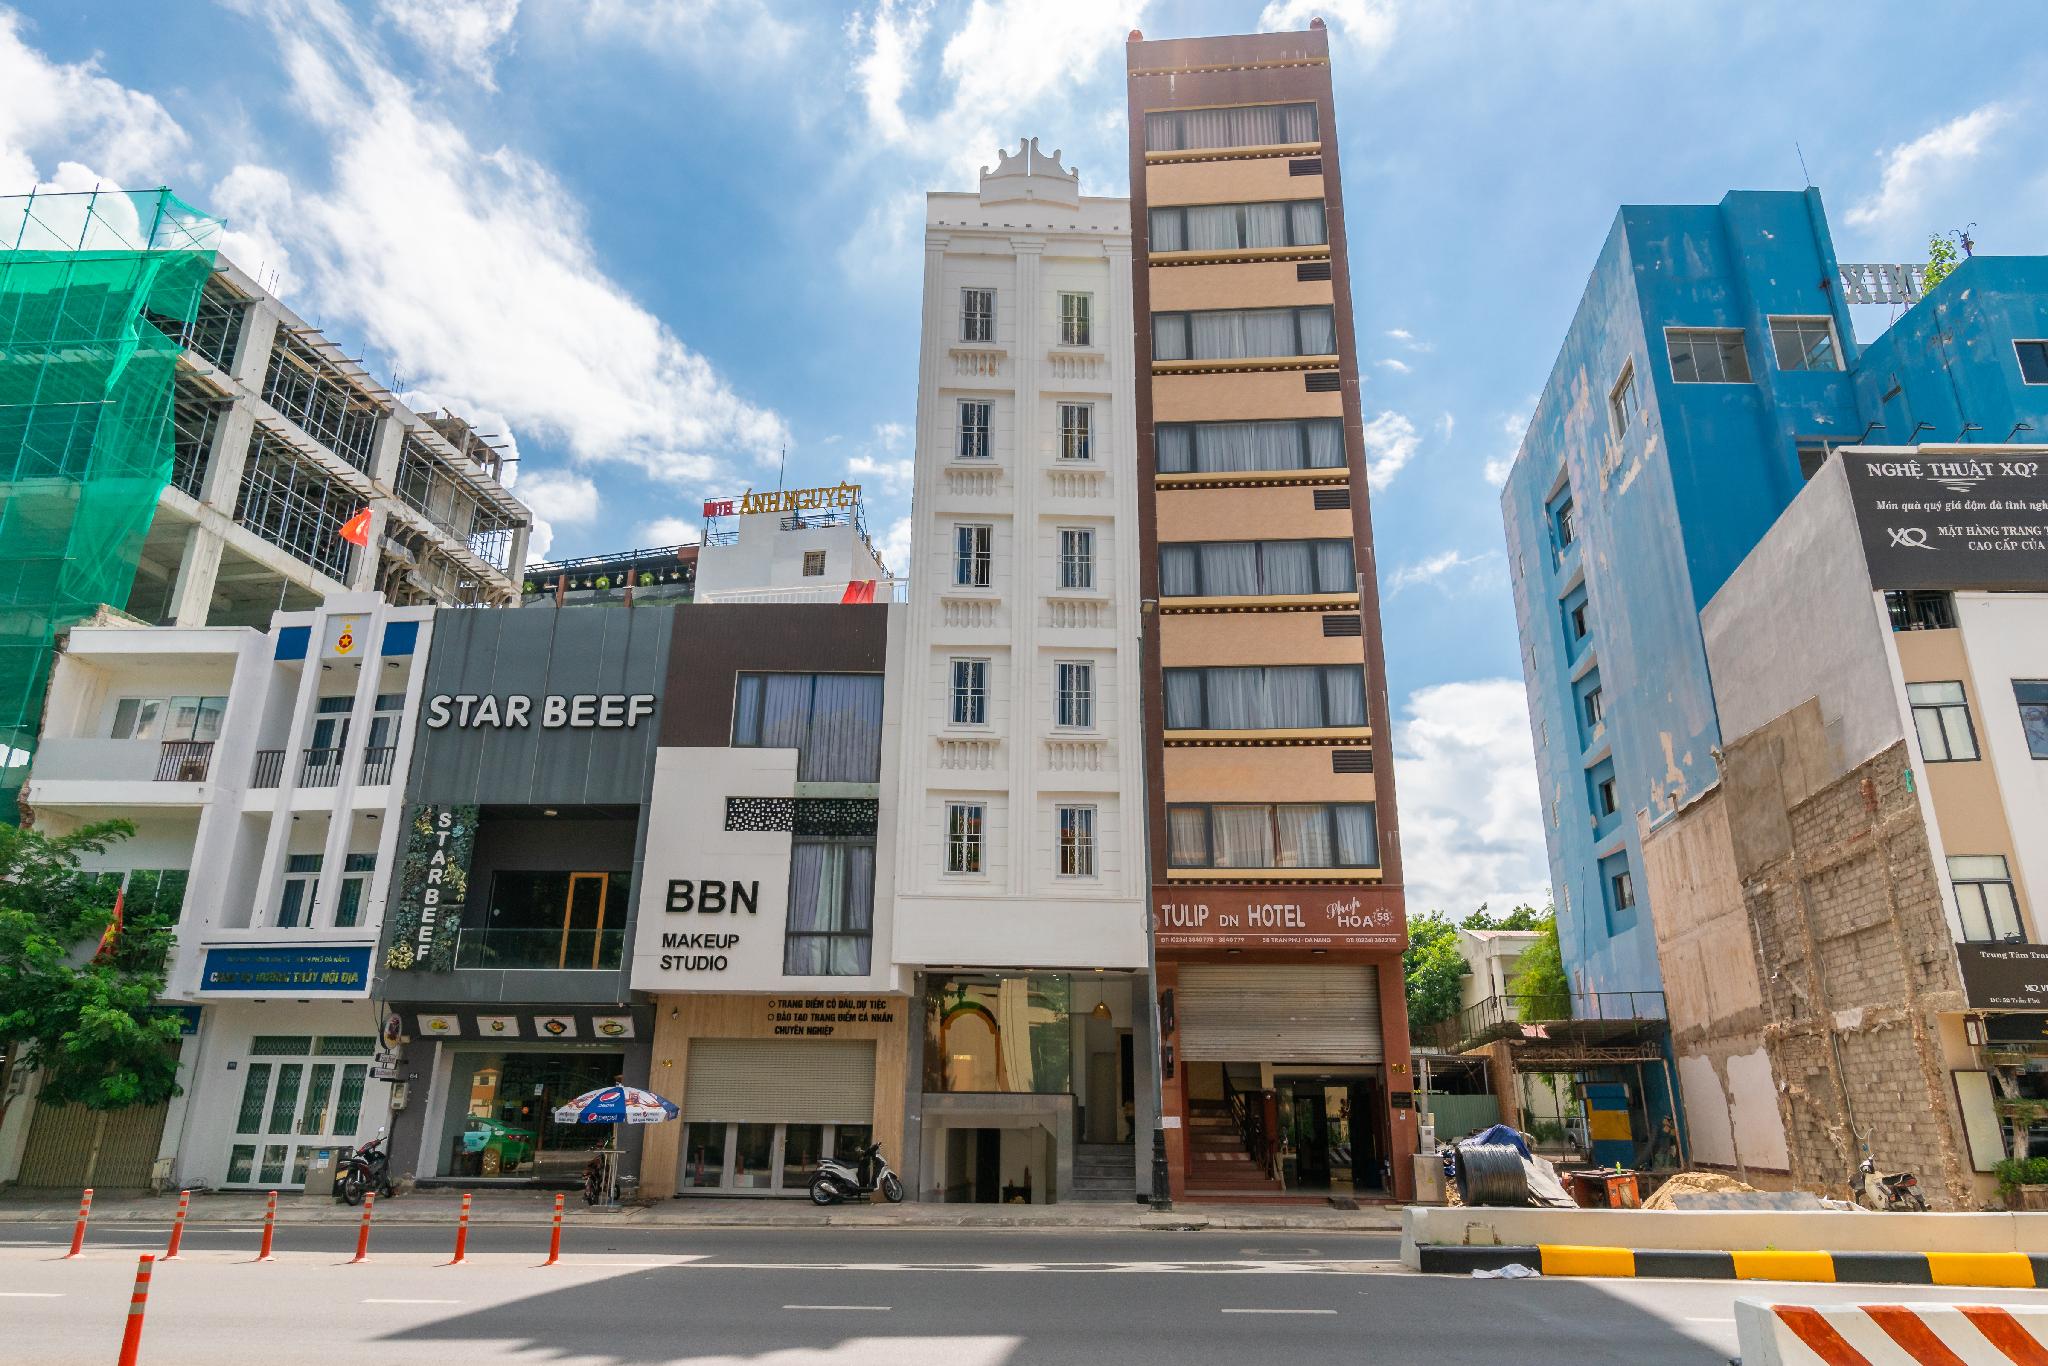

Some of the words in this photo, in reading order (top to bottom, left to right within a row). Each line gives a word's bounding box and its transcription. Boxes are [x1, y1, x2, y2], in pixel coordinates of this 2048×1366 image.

[1866, 460, 1923, 479] NGHỆ
[1928, 459, 1993, 478] THUẬT
[1999, 462, 2038, 477] XQ?
[740, 488, 781, 514] ÁNH
[784, 481, 861, 511] NGUYỆT
[1876, 501, 1898, 510] Món
[1902, 501, 1922, 512] quà
[1924, 501, 1942, 512] quý
[1945, 501, 1961, 511] giá
[2005, 500, 2027, 510] tình
[1937, 524, 1963, 537] MẶT
[1965, 524, 1999, 535] HÀNG
[2001, 526, 2042, 536] TRANG
[1888, 528, 1941, 550] XQ
[1968, 541, 1993, 550] CAO
[427, 694, 532, 728] STAR
[543, 694, 654, 728] BEEF
[428, 812, 452, 885] STAR
[666, 879, 759, 914] BBN
[1161, 903, 1210, 927] TULIP
[1220, 915, 1239, 927] DN
[1248, 903, 1306, 928] HOTEL
[1338, 915, 1374, 928] HOA
[1377, 912, 1390, 921] 58
[416, 888, 440, 961] BEEF
[662, 933, 740, 948] MAKEUP
[660, 955, 728, 971] STUDIO
[1979, 951, 2007, 959] Trung
[778, 999, 803, 1008] TRANG
[811, 1013, 835, 1022] TRANG
[774, 1024, 804, 1035] CHUYÊN
